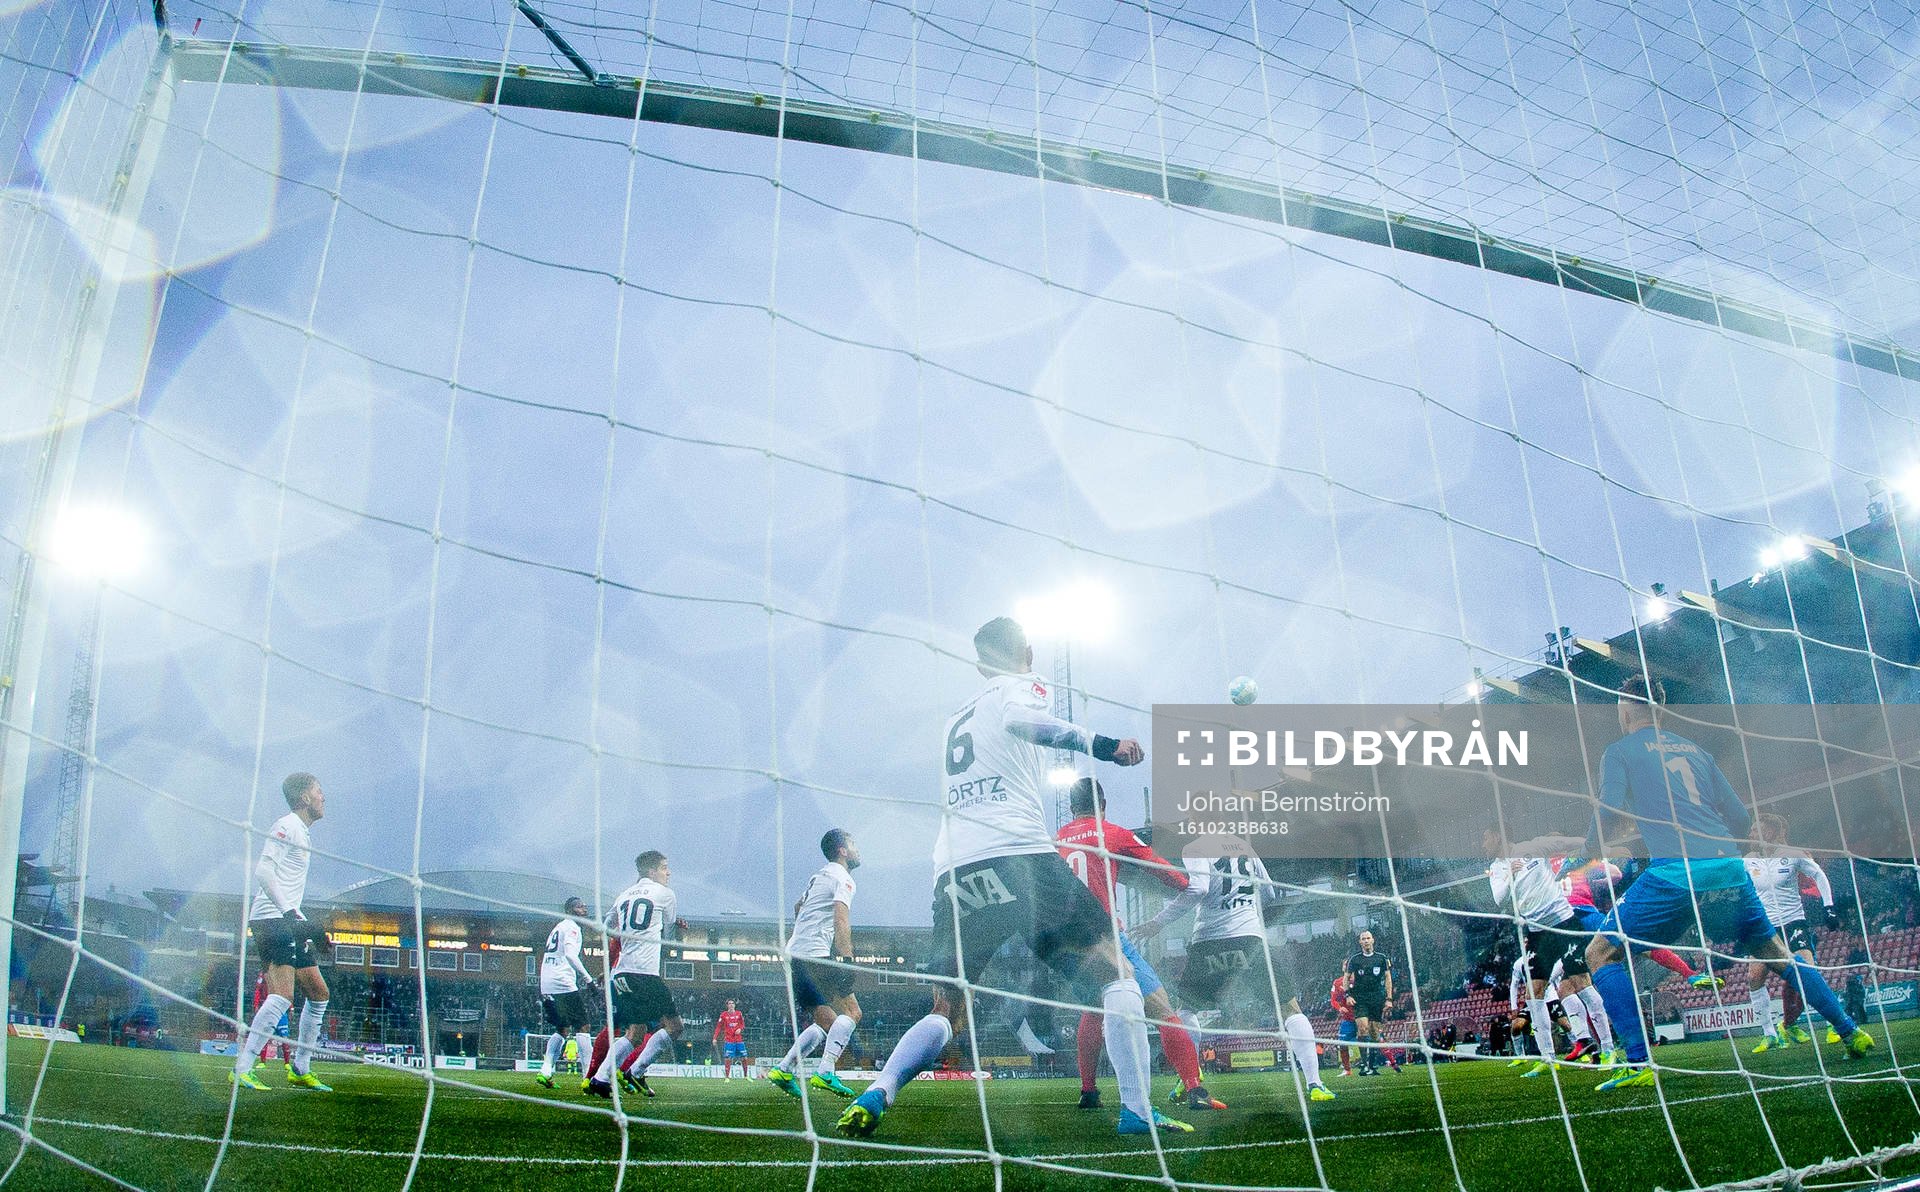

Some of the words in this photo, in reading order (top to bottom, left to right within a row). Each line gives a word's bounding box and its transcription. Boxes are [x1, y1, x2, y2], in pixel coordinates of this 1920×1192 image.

[945, 706, 975, 776] 6
[1665, 756, 1702, 805] 1
[944, 867, 1017, 915] NA
[619, 897, 654, 931] 10
[428, 940, 468, 949] SHARP
[363, 1052, 425, 1068] stadium
